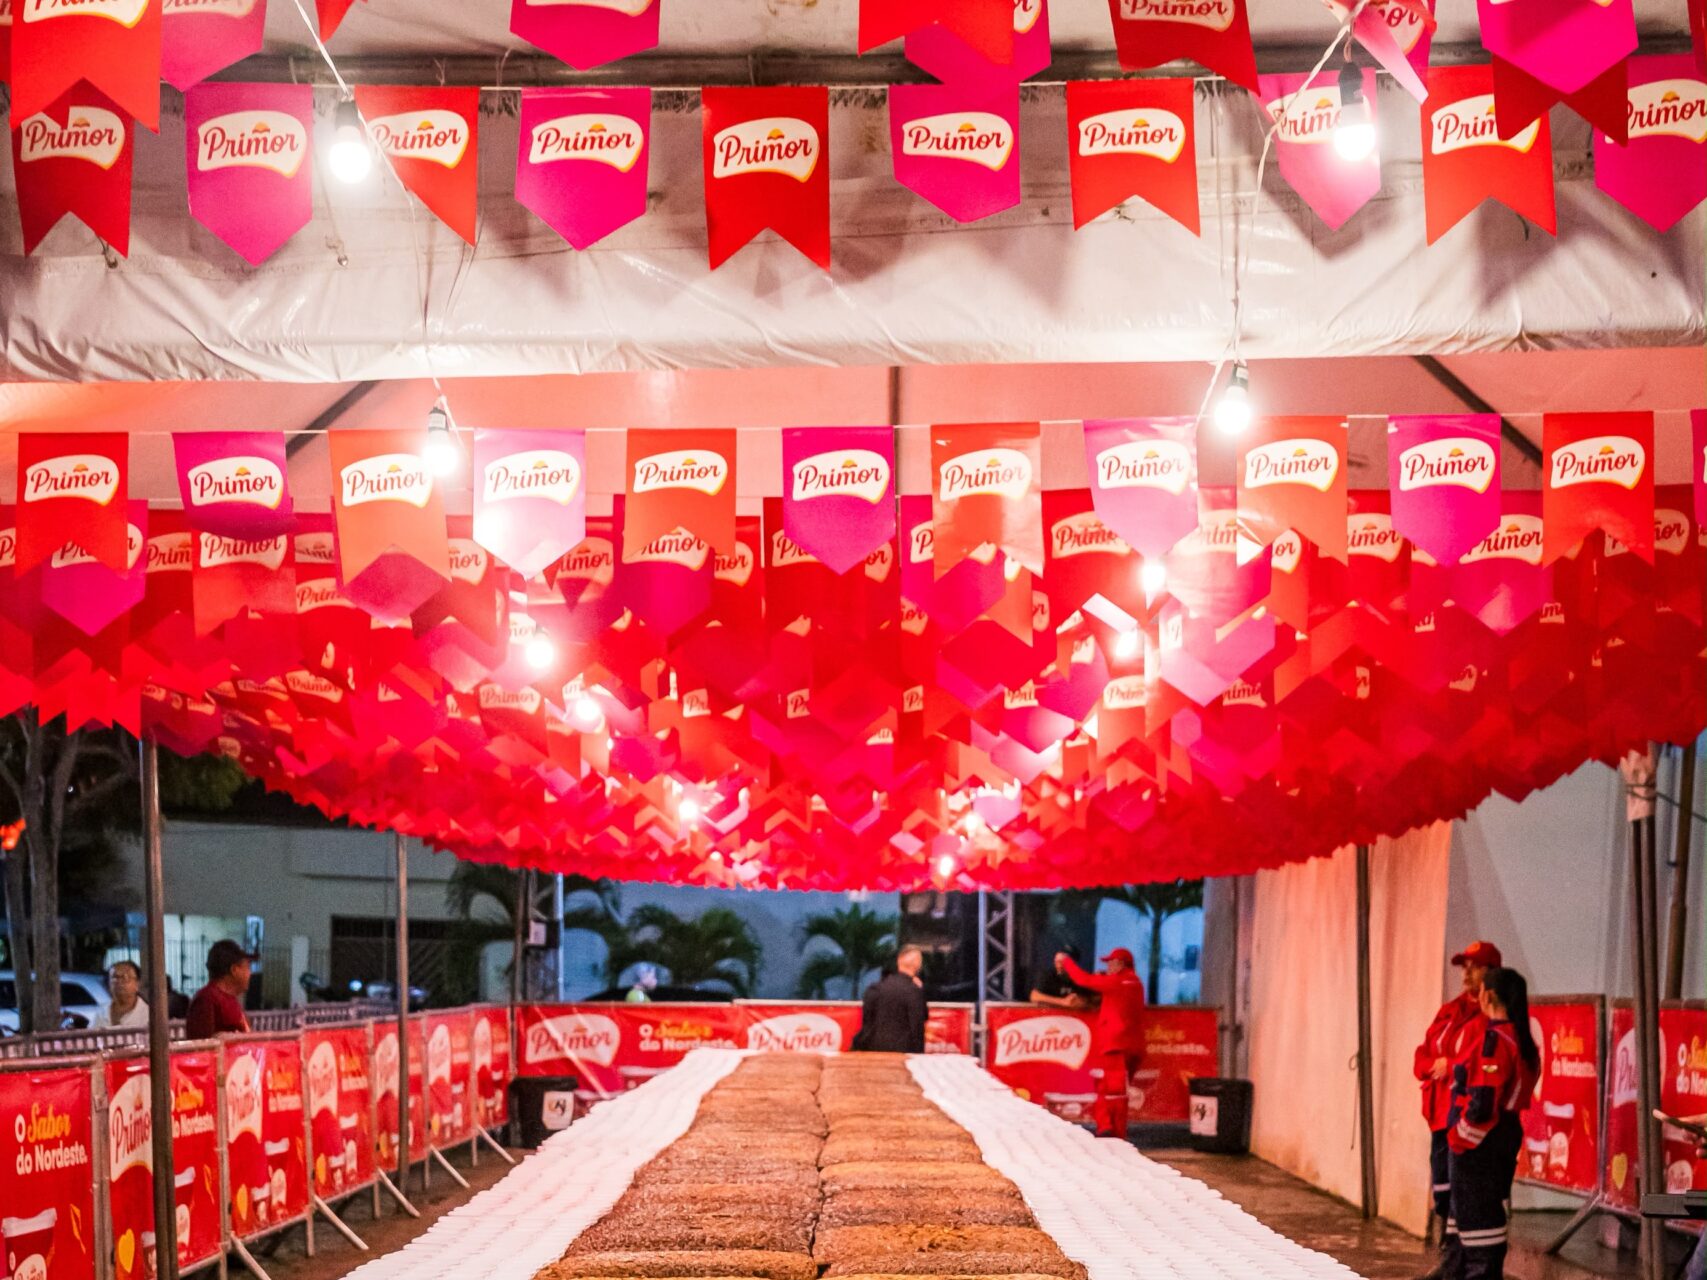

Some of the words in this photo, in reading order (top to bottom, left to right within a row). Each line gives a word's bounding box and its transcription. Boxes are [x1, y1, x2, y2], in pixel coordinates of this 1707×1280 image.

[25, 119, 117, 153] Primor
[372, 124, 461, 154] Primor
[537, 126, 635, 155] Primor
[908, 125, 1005, 151] Primor
[1084, 122, 1178, 148] Primor
[1437, 112, 1496, 143] Prim
[203, 125, 299, 161] Primor
[719, 135, 812, 168] Primor
[640, 462, 721, 485] Primor
[798, 464, 883, 492] Primor
[944, 463, 1026, 492] Primor
[1102, 453, 1185, 481] Primor
[1250, 453, 1333, 480] Primor
[1405, 452, 1489, 482] Primor
[1555, 450, 1639, 480] Primor
[30, 468, 112, 494] Primor
[194, 471, 277, 498] Primor
[346, 469, 427, 497] Primor
[489, 465, 574, 494] Primor
[147, 544, 191, 566] Prim
[641, 536, 705, 556] rimor
[1467, 529, 1543, 555] rimor
[1001, 1028, 1084, 1056] Primor
[15, 1113, 26, 1143] O
[27, 1102, 71, 1144] Sabor
[111, 1105, 151, 1164] Primo
[16, 1145, 33, 1176] do
[35, 1140, 88, 1172] Nordeste.
